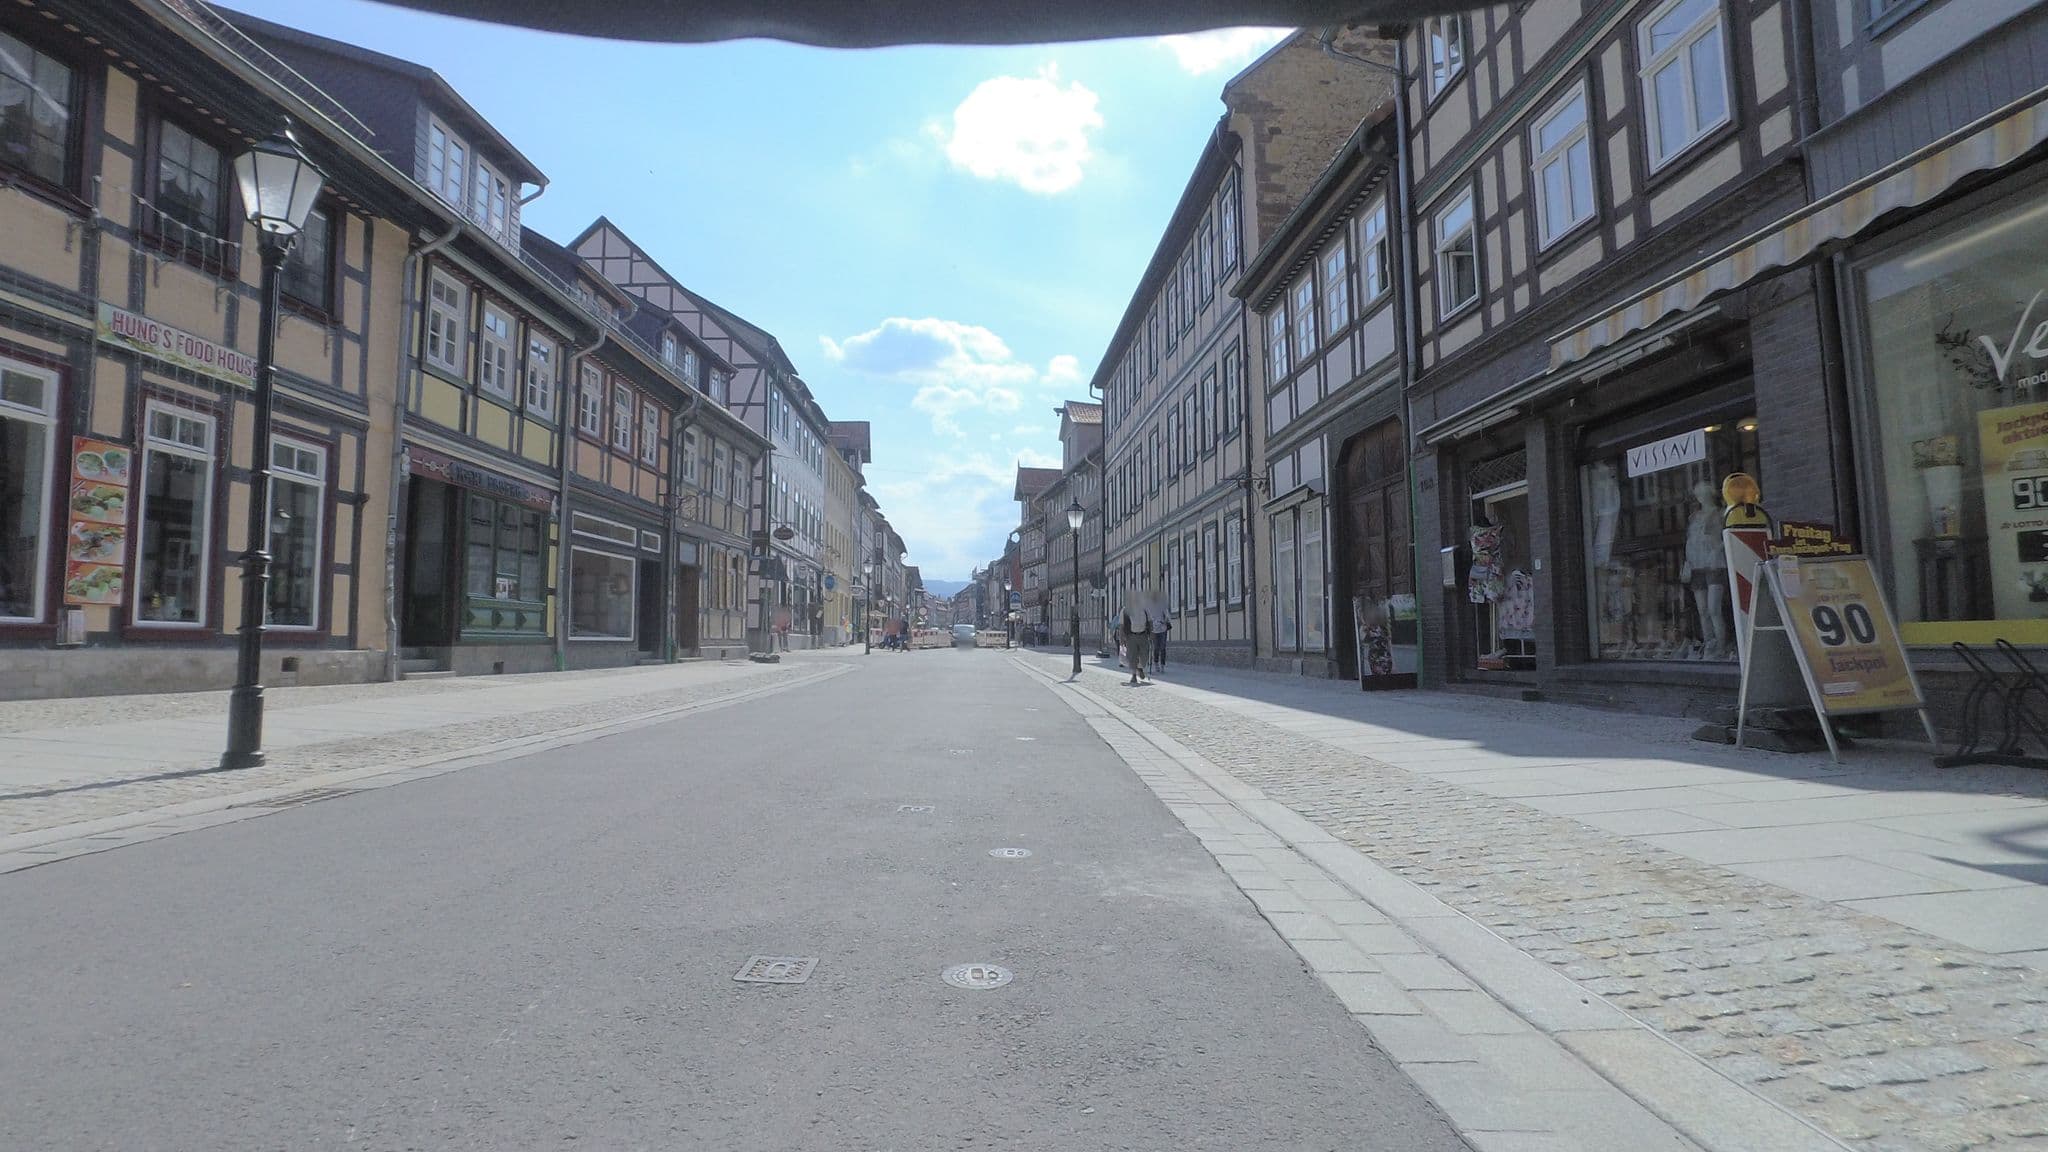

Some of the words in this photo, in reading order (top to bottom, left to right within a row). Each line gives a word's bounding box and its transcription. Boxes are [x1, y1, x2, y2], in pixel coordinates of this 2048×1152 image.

[112, 311, 172, 349] HUNG'S
[176, 334, 214, 363] FOOD
[1632, 433, 1697, 469] VISSAVI
[1783, 524, 1832, 543] Freitag
[2013, 519, 2044, 529] LOTTO
[1811, 603, 1876, 646] 90
